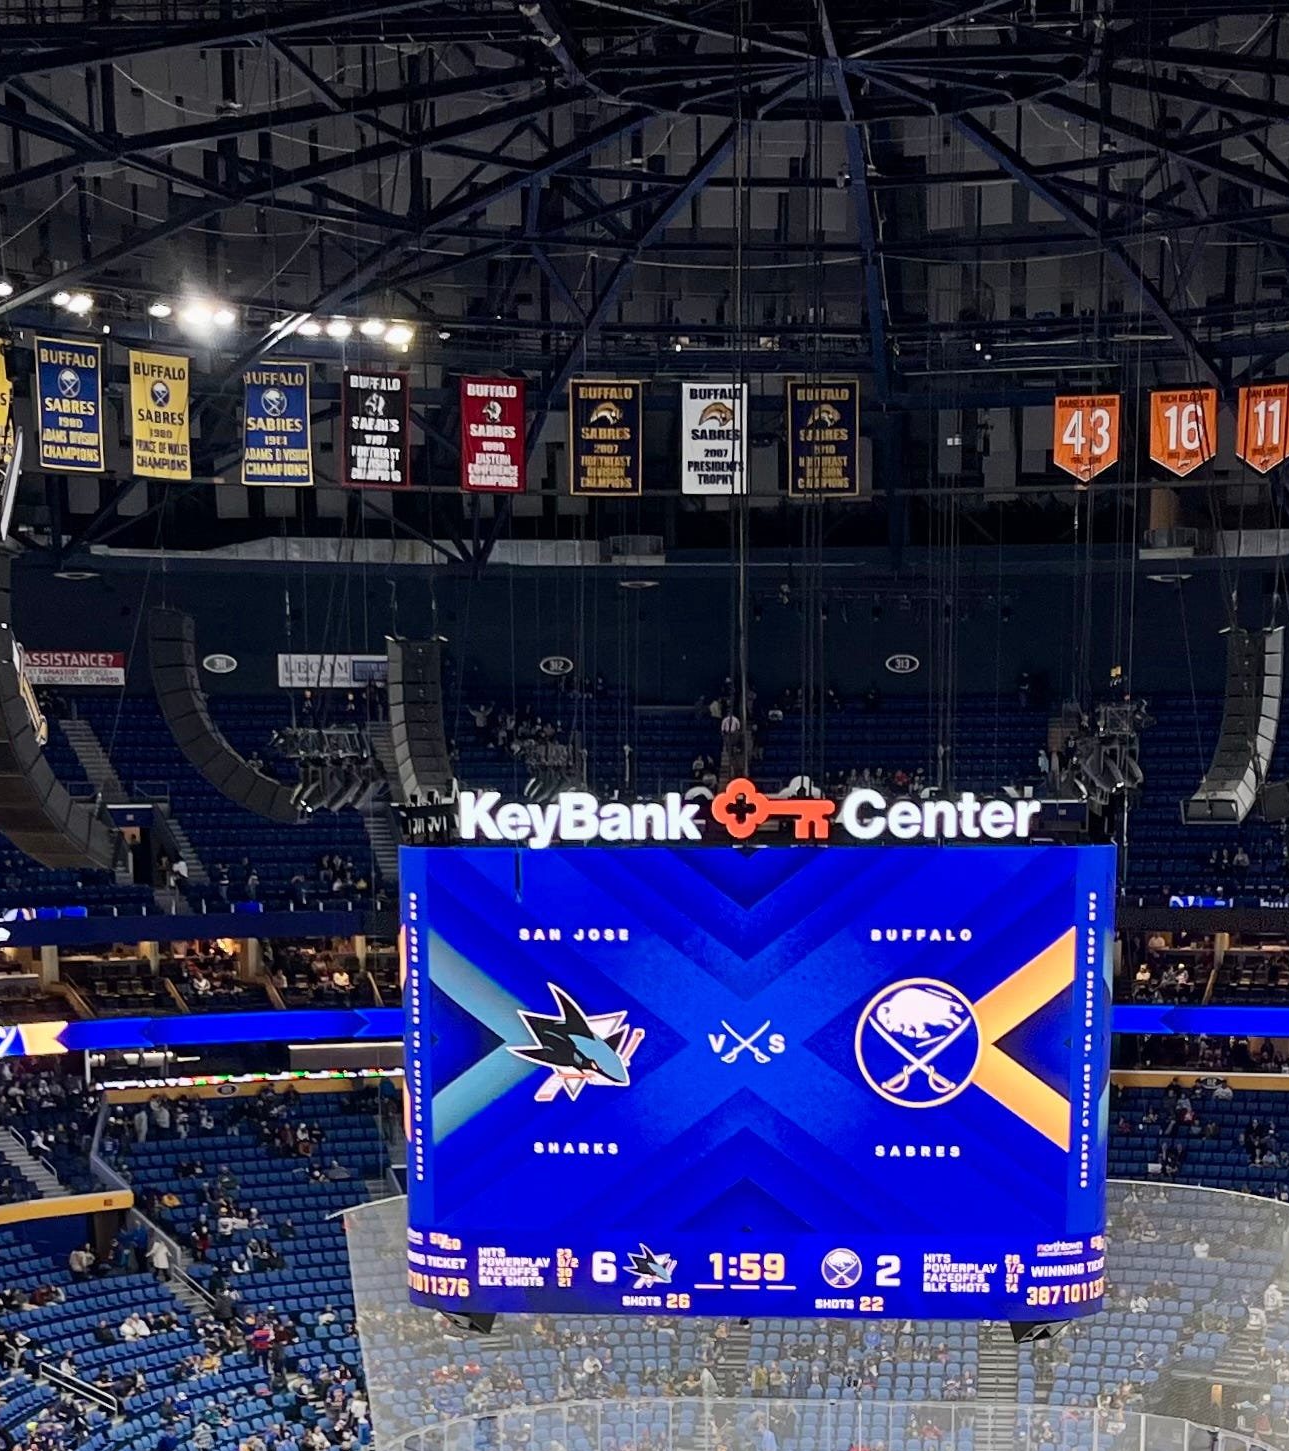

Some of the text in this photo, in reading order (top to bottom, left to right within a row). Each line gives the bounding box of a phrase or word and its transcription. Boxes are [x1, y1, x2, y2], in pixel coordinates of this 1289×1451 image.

[40, 348, 96, 369] BUFFALO
[133, 362, 186, 381] BUFFALO
[349, 374, 401, 391] BUFFALO
[467, 383, 517, 398] BUFFALO
[579, 387, 633, 400] BUFFALO
[44, 397, 95, 416] SABRES
[138, 408, 185, 426] SABRES
[1253, 400, 1281, 446] 11
[247, 417, 303, 432] SABRES
[469, 424, 516, 439] SABRES
[1164, 404, 1203, 450] 16
[581, 427, 631, 440] SABRES
[691, 429, 740, 441] SABRES
[1062, 409, 1111, 456] 43
[43, 444, 99, 463] CHAMPIONS
[136, 455, 188, 472] CHAMPIONS
[246, 463, 309, 476] CHAMPIONS
[697, 473, 734, 485] TROPHY
[460, 789, 1041, 849] KeyBank Center
[519, 928, 629, 941] SAN JOSE
[870, 928, 972, 942] BUFFALO
[533, 1141, 618, 1155] SHARKS
[875, 1145, 960, 1158] SABRES
[478, 1247, 506, 1258] HITS
[1037, 1240, 1083, 1252] northtown
[427, 1255, 467, 1269] TICKET
[478, 1257, 550, 1268] POWERPLAY
[923, 1253, 951, 1263] HITS
[478, 1268, 539, 1277] FACEOFFS
[592, 1251, 617, 1283] 6
[710, 1252, 786, 1282] 1:59
[875, 1255, 901, 1287] 2
[923, 1263, 997, 1274] POWERPLAY
[1031, 1263, 1084, 1277] WINNING
[478, 1277, 503, 1286] BLK
[504, 1277, 544, 1287] SHOTS
[923, 1273, 985, 1283] FACEOFFS
[923, 1283, 946, 1292] BLK
[950, 1283, 990, 1293] SHOTS
[622, 1294, 690, 1309] SHOTS 26
[815, 1296, 884, 1311] SHOTS 22
